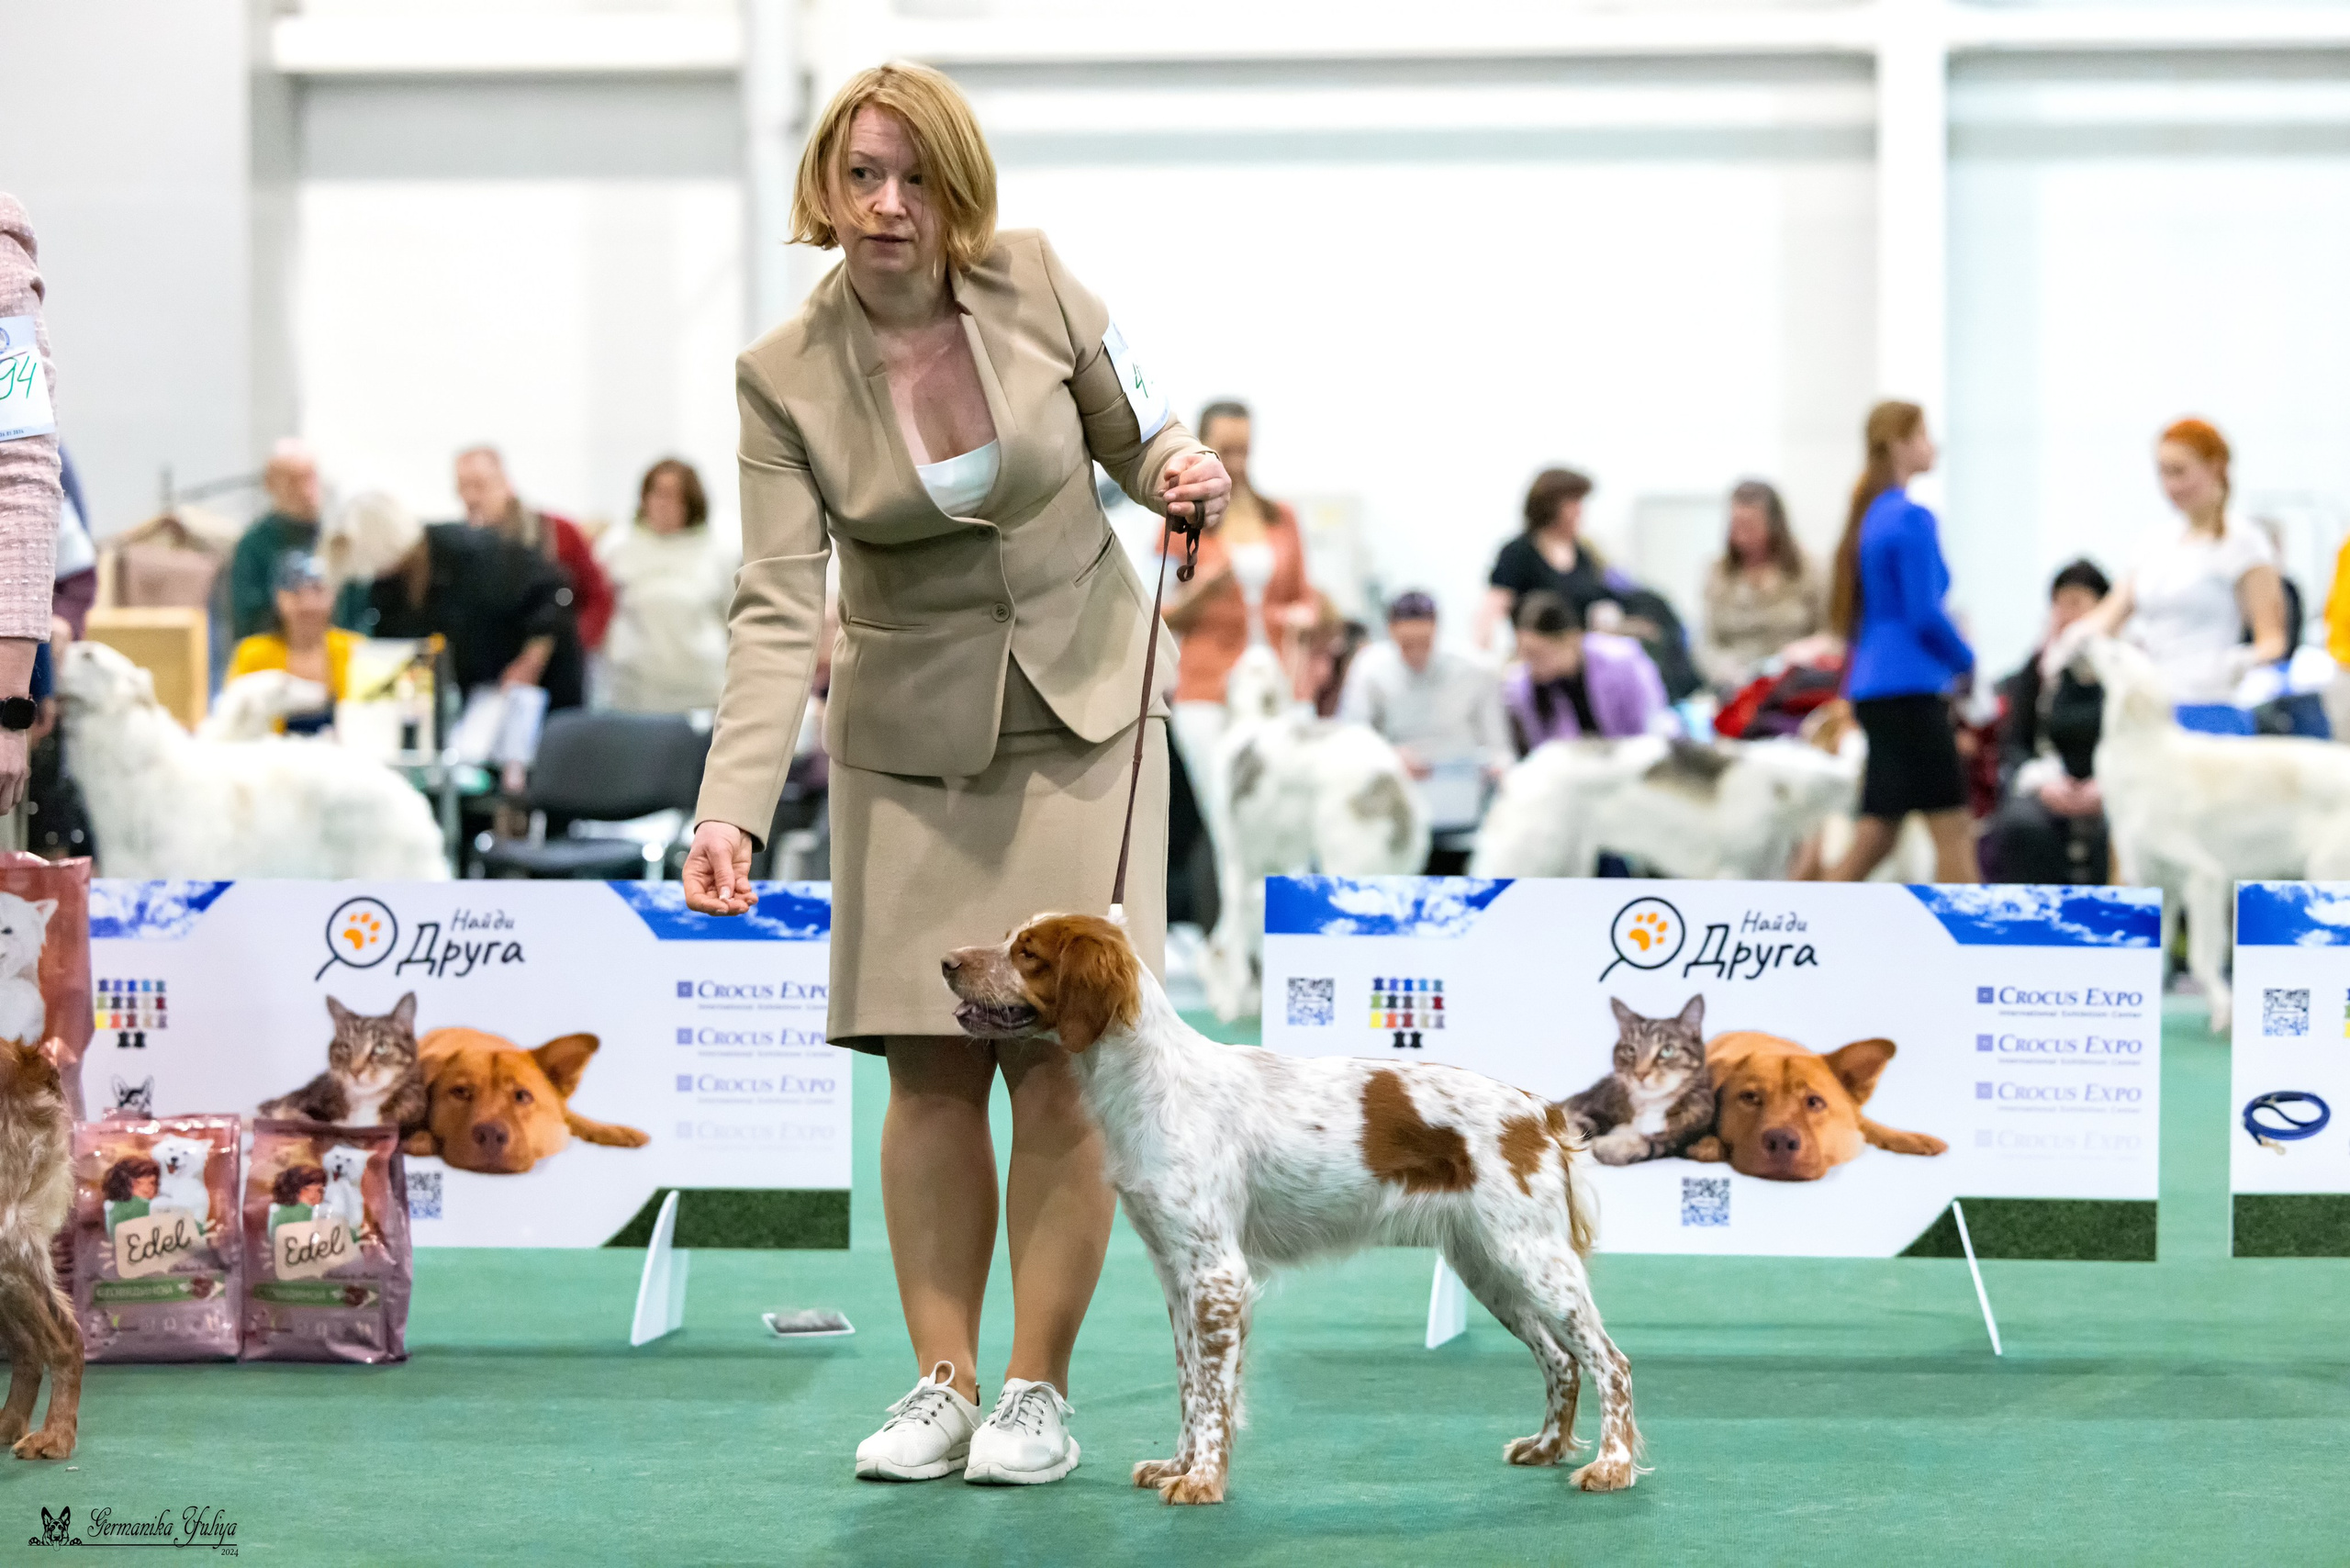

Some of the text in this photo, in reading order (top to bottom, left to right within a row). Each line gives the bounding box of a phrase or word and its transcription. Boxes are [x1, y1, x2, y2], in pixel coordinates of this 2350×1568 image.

[450, 909, 515, 931] Найди
[1740, 910, 1807, 933] Найди
[396, 922, 525, 978] Друга
[1683, 924, 1818, 980] Друга
[697, 980, 774, 999] CROCUS
[1998, 986, 2143, 1007] CROCUS EXPO
[697, 1027, 774, 1046] CROCUS
[1997, 1034, 2143, 1055] CROCUS EXPO
[696, 1074, 835, 1092] CROCUS EXPO
[1997, 1081, 2143, 1103] CROCUS EXPO
[127, 1219, 192, 1263] Edel
[285, 1226, 346, 1266] Edel
